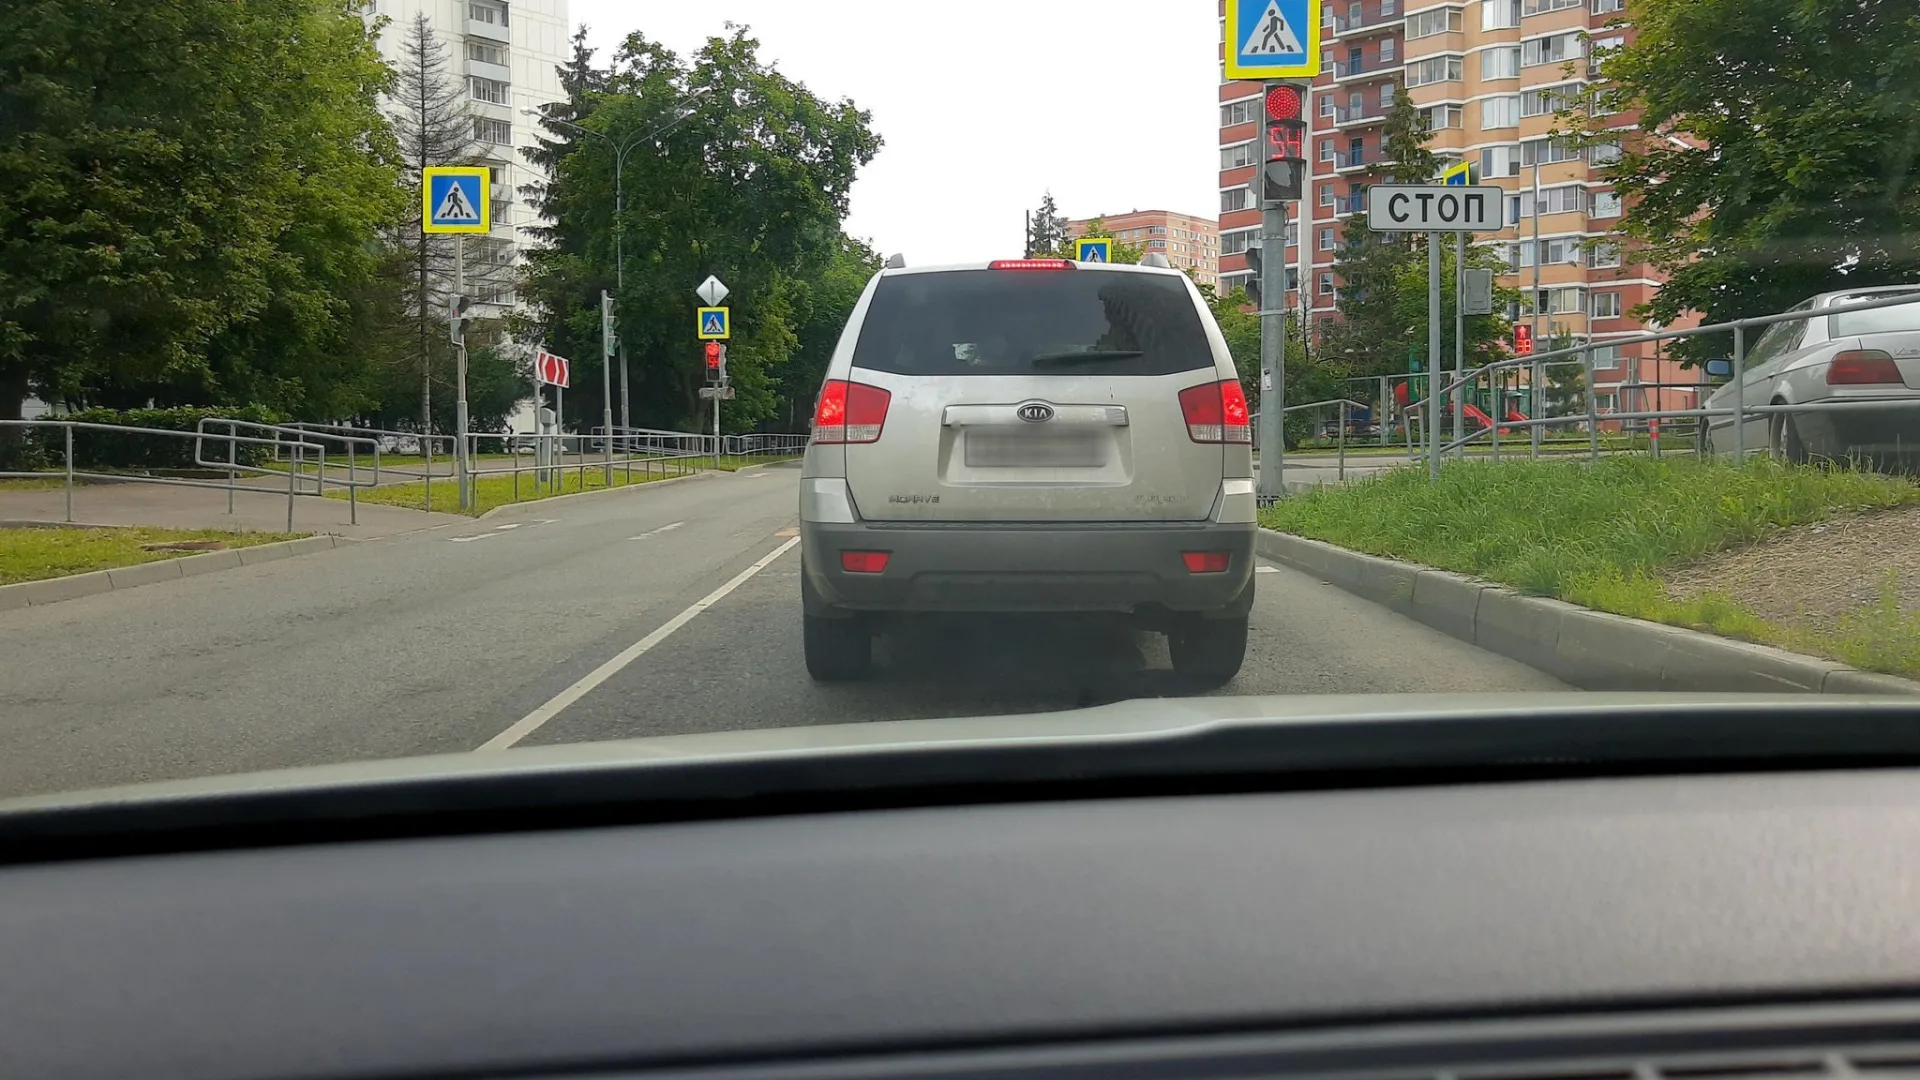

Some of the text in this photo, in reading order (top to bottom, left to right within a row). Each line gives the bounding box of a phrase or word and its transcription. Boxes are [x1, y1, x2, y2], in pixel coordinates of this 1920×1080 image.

[1269, 127, 1302, 159] 54
[1388, 193, 1484, 223] СТОП
[1024, 408, 1048, 418] KIA
